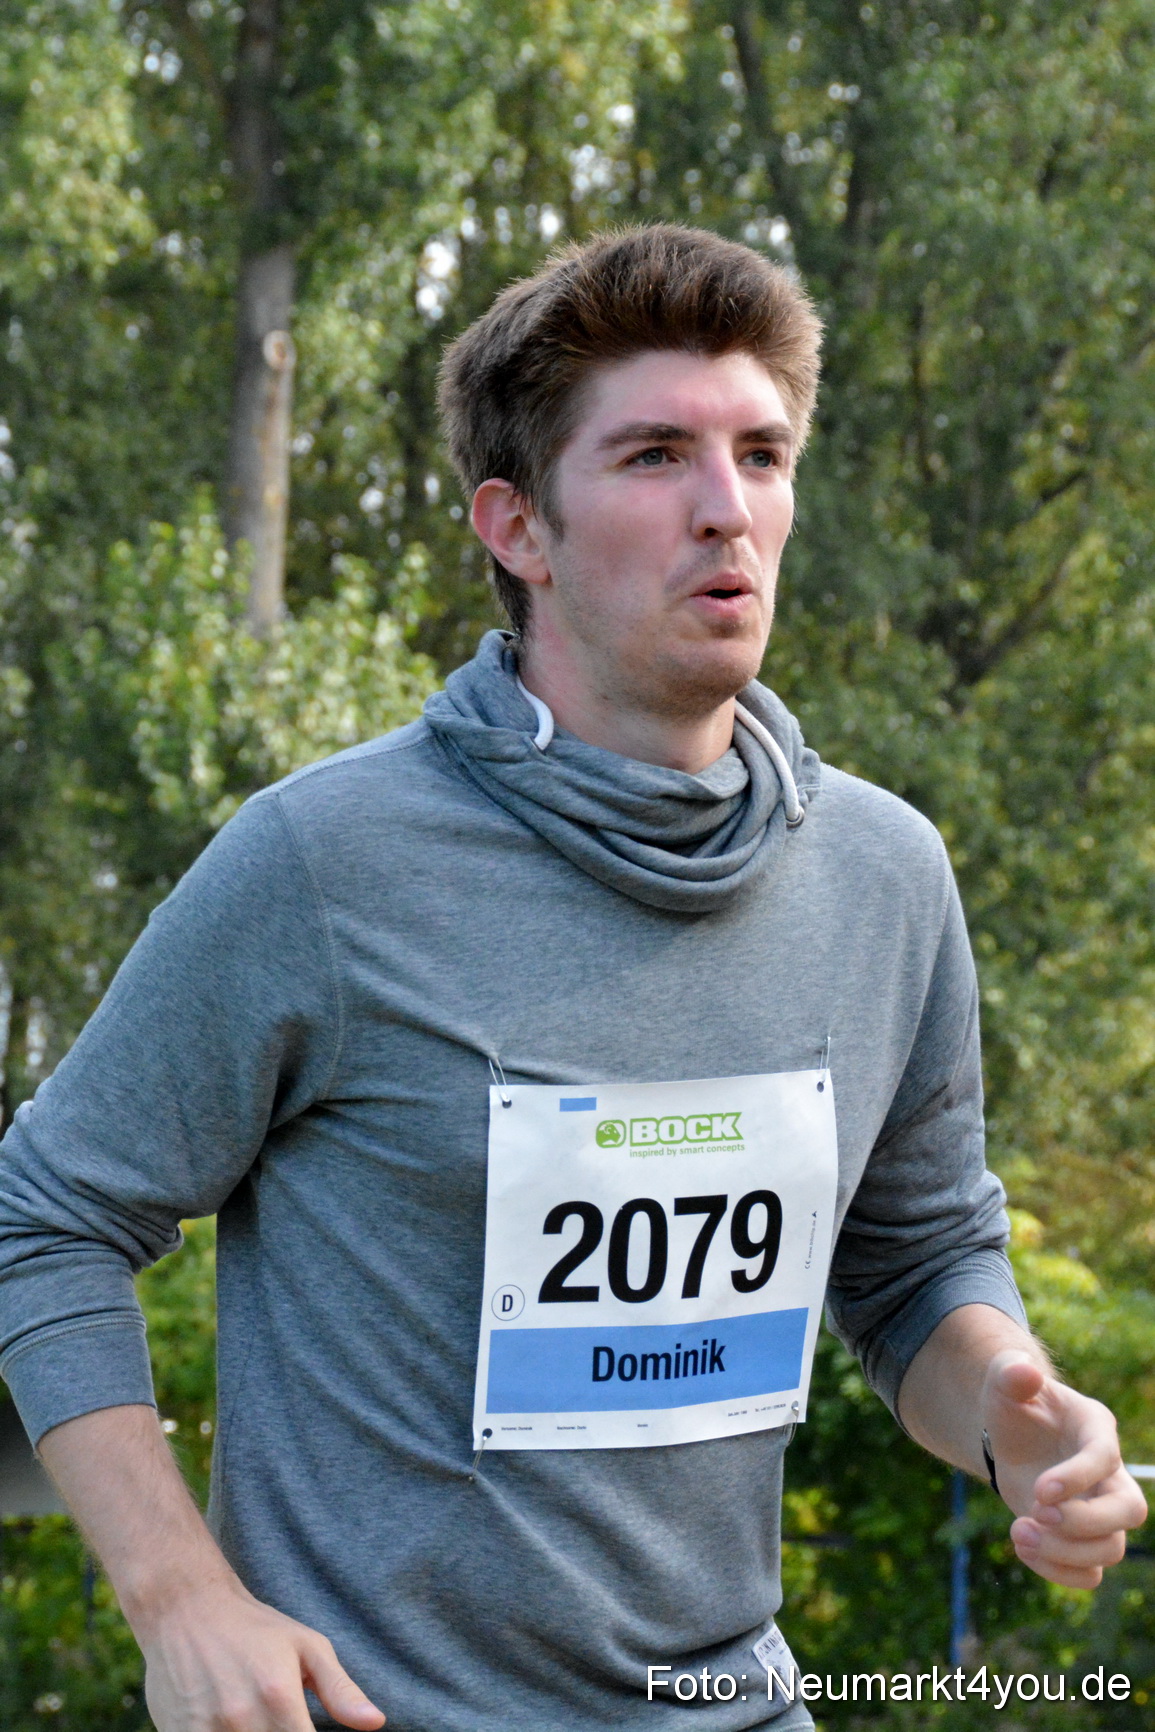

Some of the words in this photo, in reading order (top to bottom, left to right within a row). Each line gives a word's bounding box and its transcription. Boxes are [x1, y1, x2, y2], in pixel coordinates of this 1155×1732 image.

[630, 1112, 743, 1146] BOCK
[630, 1149, 664, 1159] inspired
[667, 1149, 677, 1157] by
[680, 1146, 704, 1154] smart
[707, 1143, 745, 1153] concepts
[538, 1189, 783, 1304] 2079
[501, 1294, 514, 1313] D
[592, 1338, 726, 1382] Dominik
